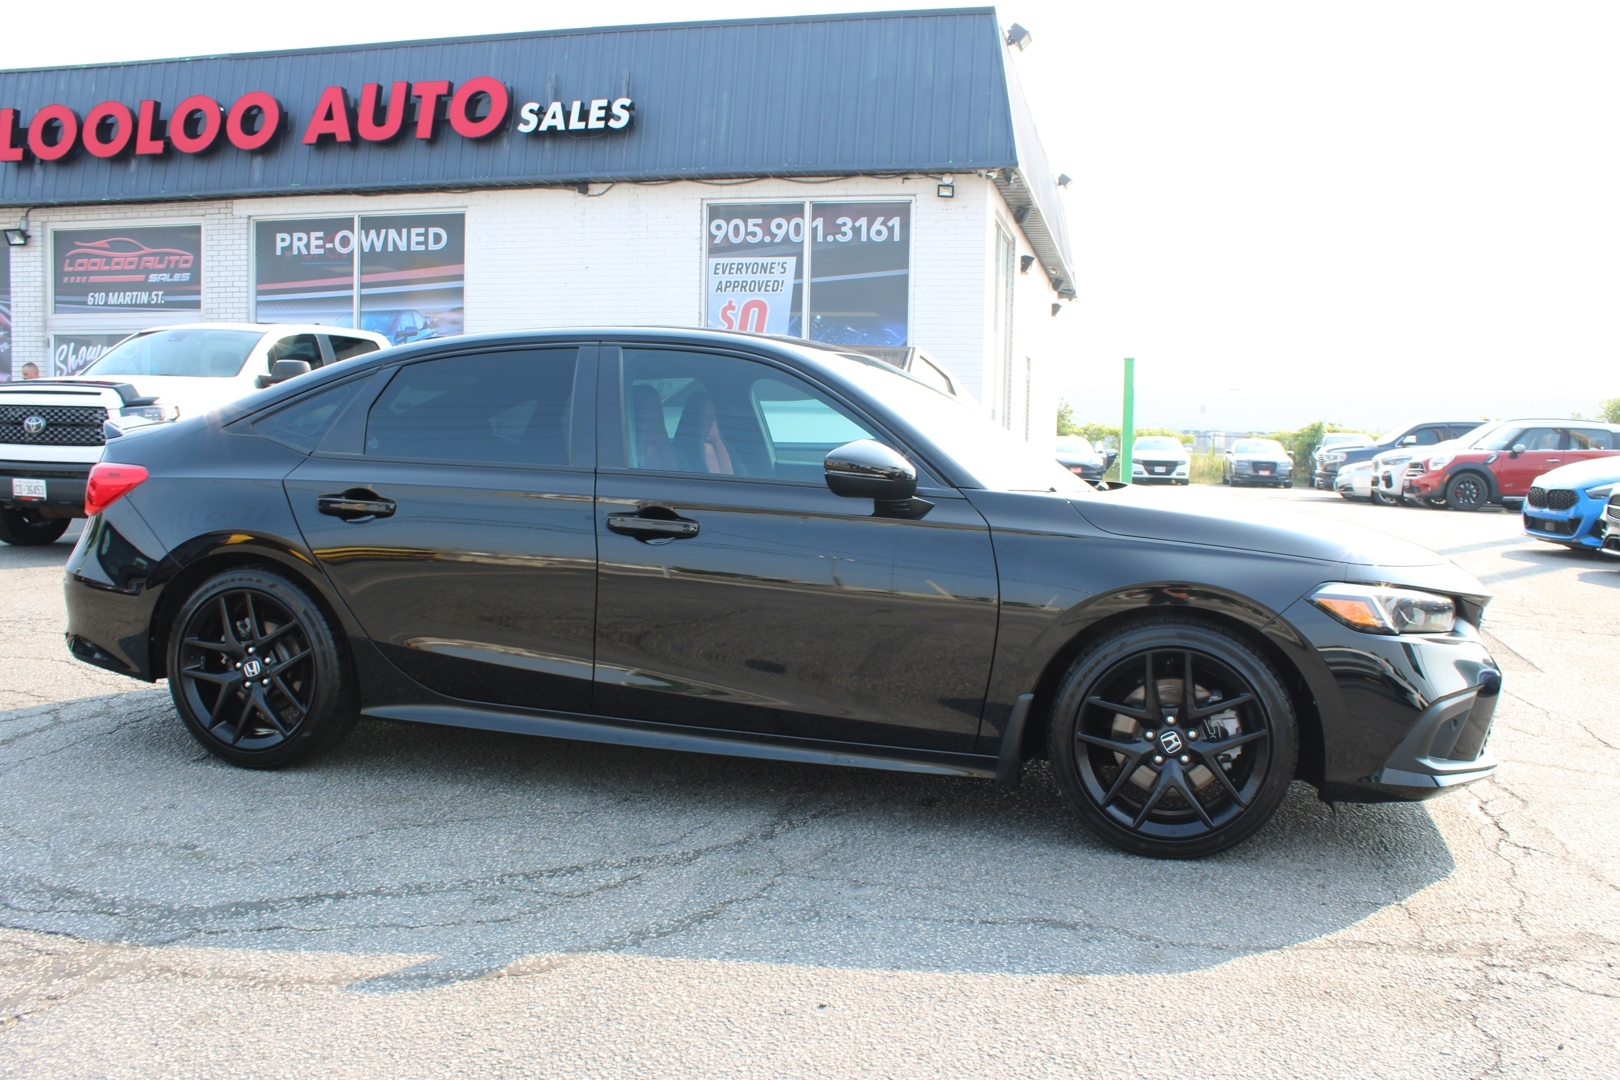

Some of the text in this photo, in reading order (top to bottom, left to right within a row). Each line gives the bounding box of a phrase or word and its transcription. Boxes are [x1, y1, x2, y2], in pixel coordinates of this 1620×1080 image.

[0, 76, 632, 161] LOOLOO AUTO SALES
[709, 216, 900, 244] 905.901.3161
[275, 227, 448, 256] PRE-OWNED
[63, 255, 194, 271] LOOLOO AUTO
[713, 261, 787, 276] EVERYONE'S
[148, 272, 191, 283] SALES
[715, 279, 784, 293] APPROVED!
[87, 290, 165, 305] 610 MARTIN ST.
